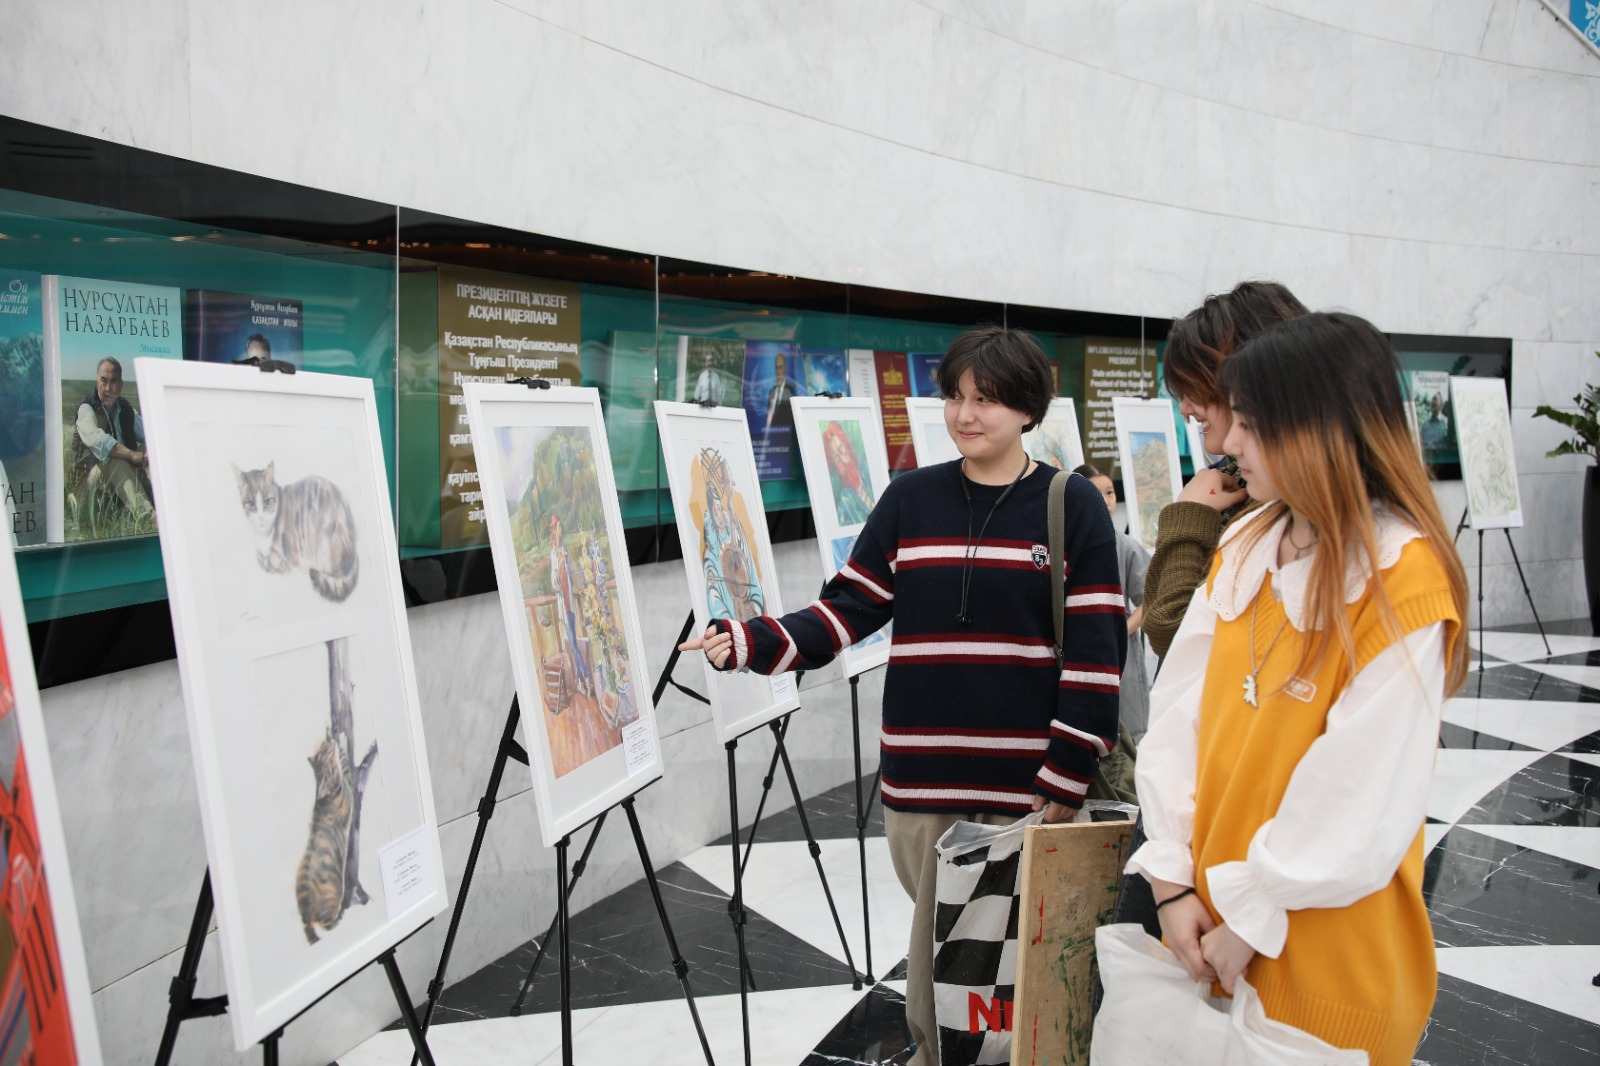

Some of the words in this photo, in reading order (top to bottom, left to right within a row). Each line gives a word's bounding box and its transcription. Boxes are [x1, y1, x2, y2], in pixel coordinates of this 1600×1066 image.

[63, 288, 168, 316] НУРСУЛТАН
[457, 283, 530, 307] ПРЕЗИДЕНТТІҢ
[65, 312, 170, 338] НАЗАРБАЕВ
[468, 304, 502, 322] АСҚАН
[504, 308, 557, 326] ИДЕЯЛАРЫ
[444, 331, 493, 349] Қазақстан
[495, 334, 578, 355] Республикасының
[507, 354, 558, 372] Президенті
